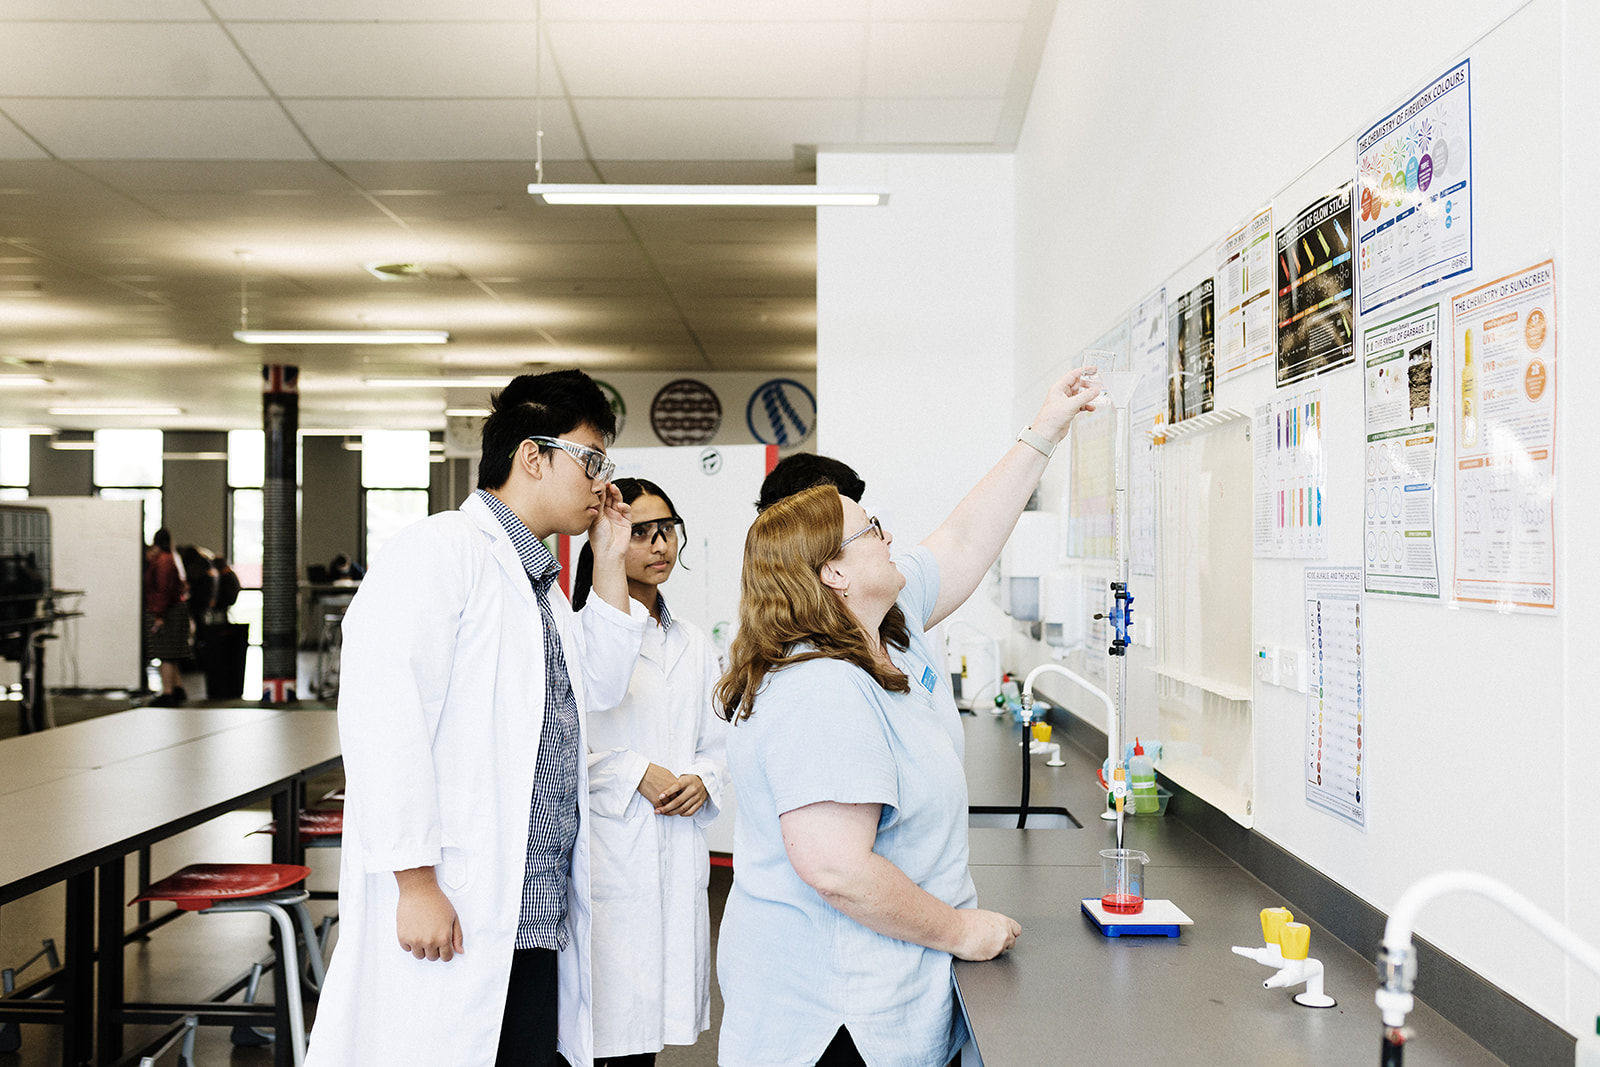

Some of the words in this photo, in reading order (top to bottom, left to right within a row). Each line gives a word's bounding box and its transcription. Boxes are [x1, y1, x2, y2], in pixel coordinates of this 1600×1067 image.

[1359, 138, 1367, 152] THE
[1367, 117, 1396, 146] CHEMISTRY
[1396, 111, 1404, 126] OF
[1404, 92, 1433, 120] FIREWORK
[1433, 68, 1465, 99] COLOURS
[1306, 214, 1313, 228] OF
[1313, 203, 1329, 223] GLOW
[1329, 190, 1350, 214] STICKS
[1455, 300, 1466, 313] THE
[1466, 288, 1498, 309] CHEMISTRY
[1500, 284, 1509, 297] OF
[1510, 268, 1550, 293] SUNSCREEN
[1374, 338, 1383, 347] THE
[1383, 334, 1396, 346] SMELL
[1397, 331, 1404, 342] OF
[1403, 324, 1425, 340] GARBAGE
